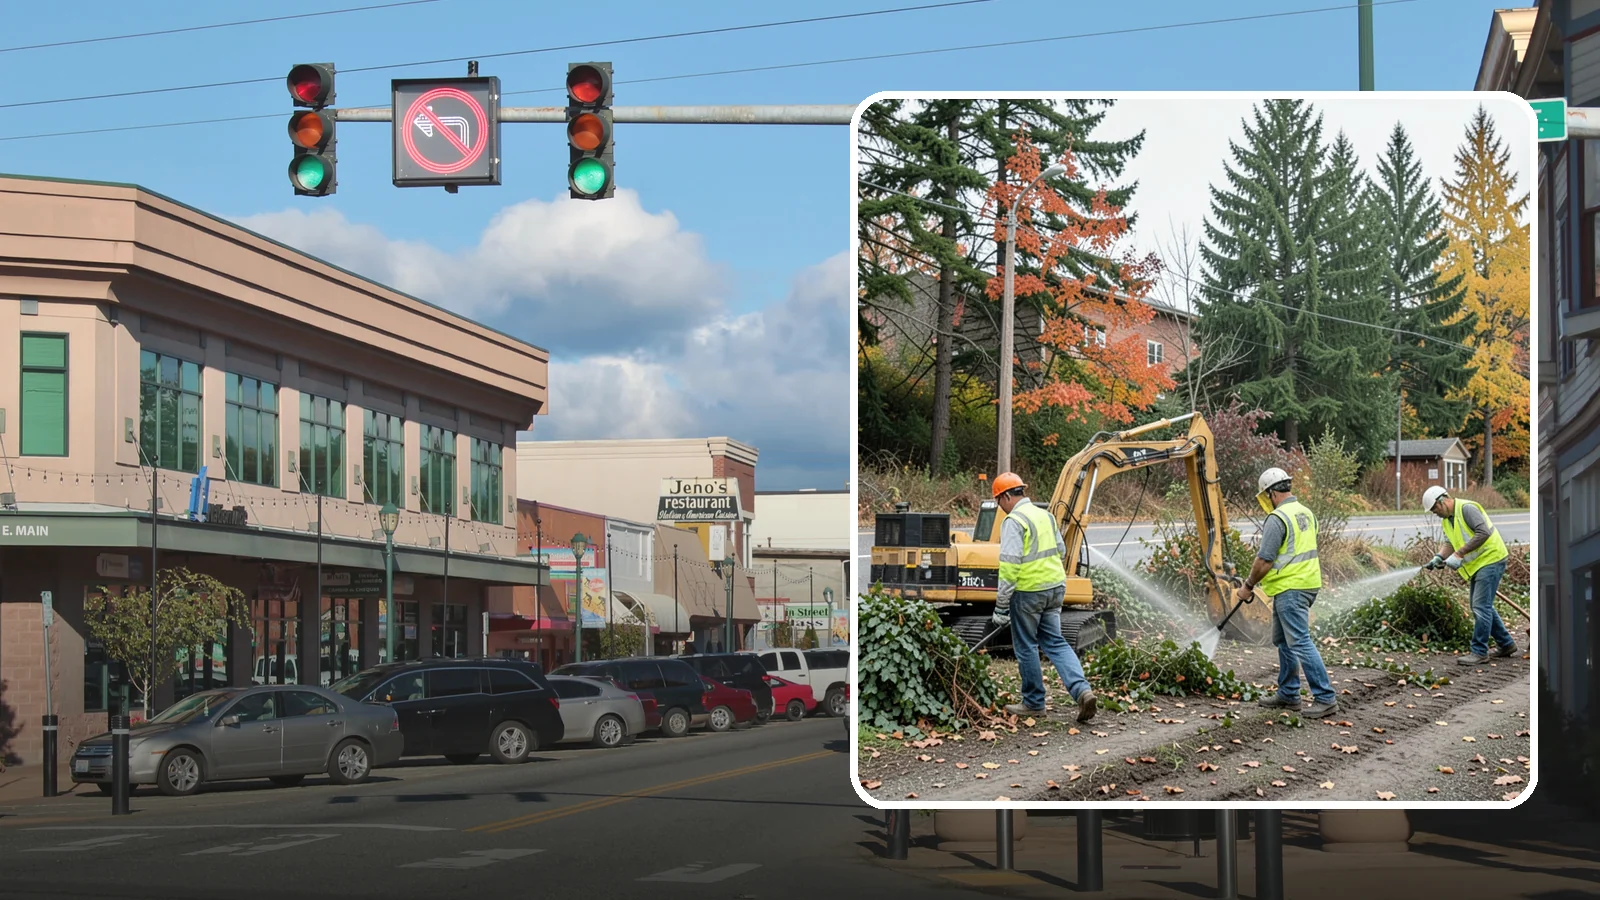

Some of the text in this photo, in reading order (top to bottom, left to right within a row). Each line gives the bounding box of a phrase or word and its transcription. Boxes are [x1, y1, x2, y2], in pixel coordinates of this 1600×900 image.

[670, 480, 727, 494] Jeno's
[665, 496, 731, 509] restaurant
[658, 510, 681, 519] Italian
[686, 510, 714, 519] American
[715, 509, 737, 519] Cuisine
[2, 525, 49, 536] E. MAIN
[797, 607, 828, 616] Street
[790, 619, 823, 627] lass
